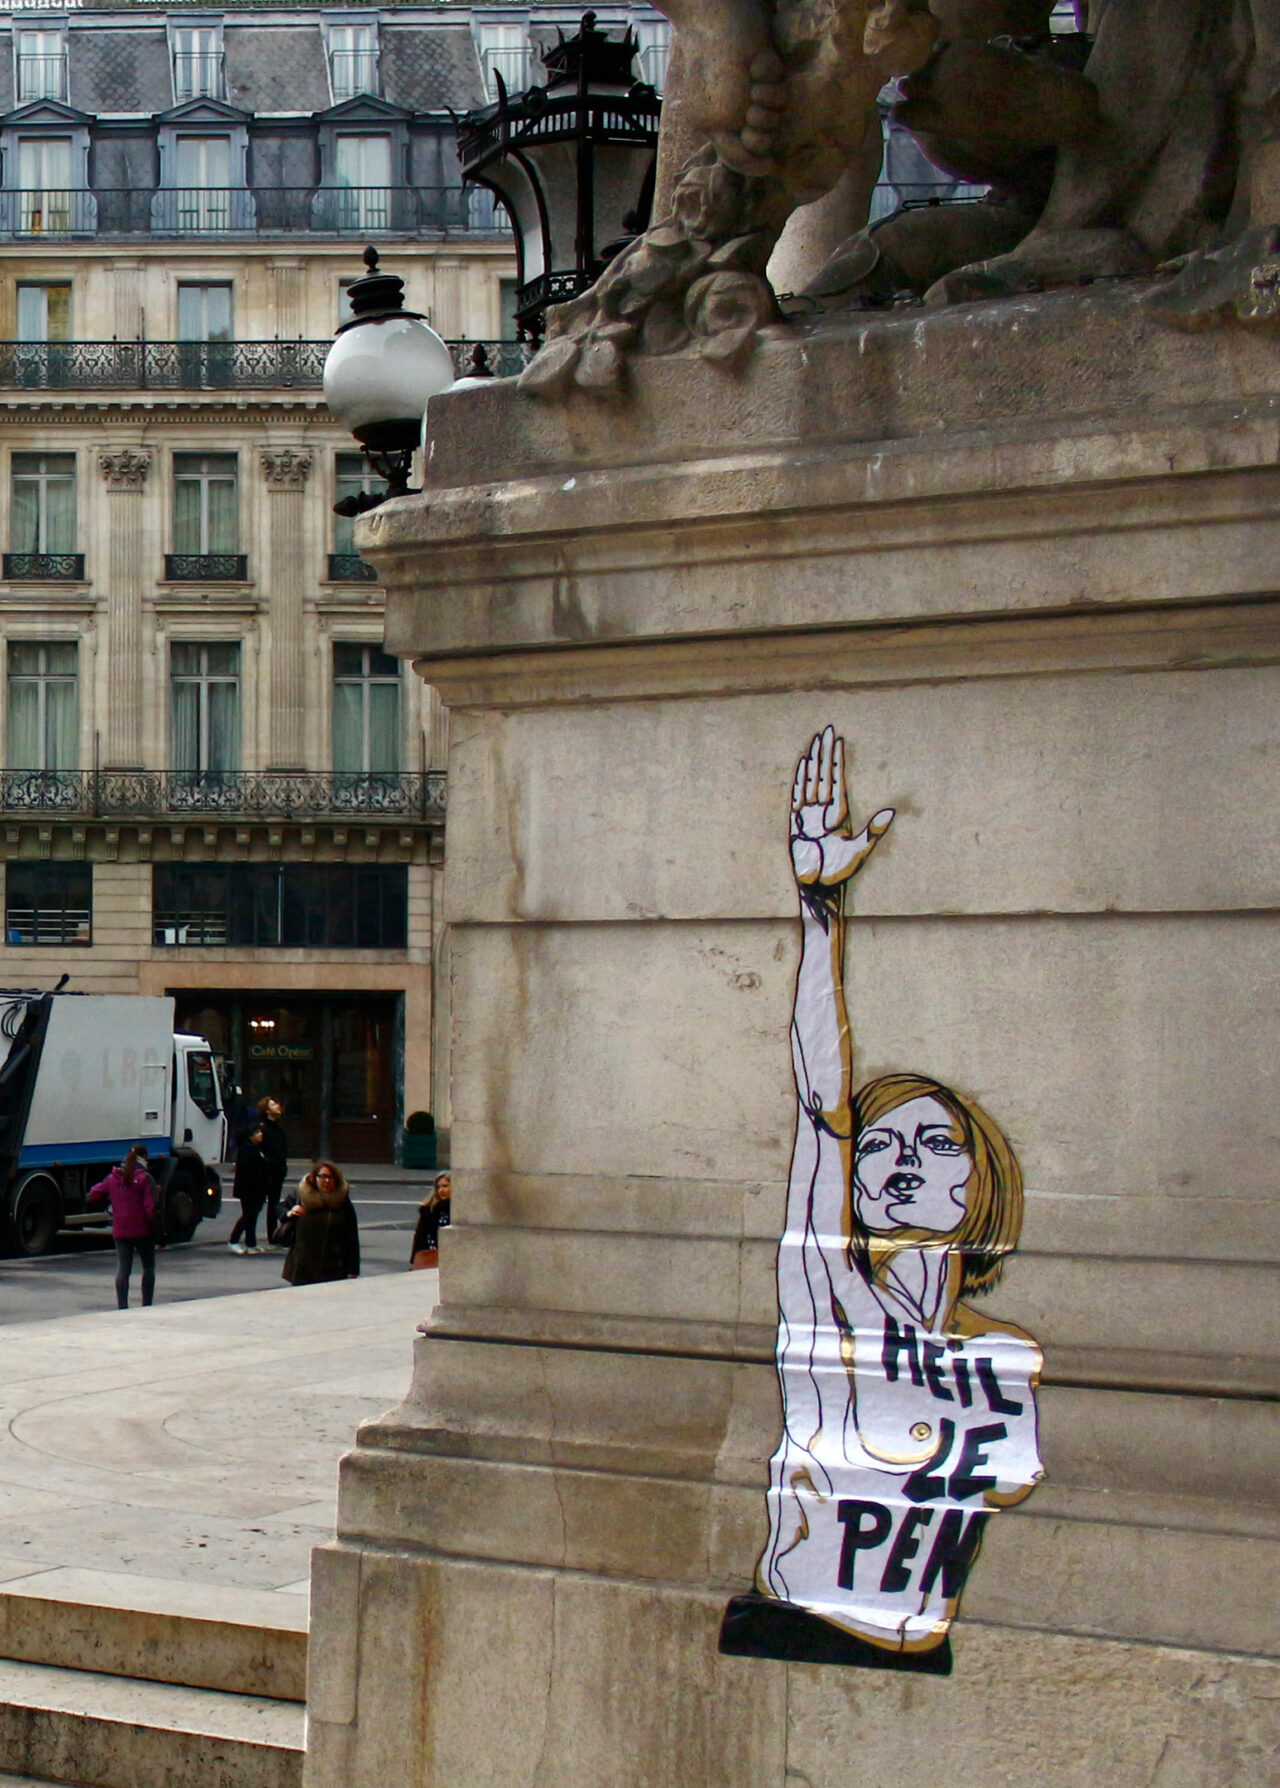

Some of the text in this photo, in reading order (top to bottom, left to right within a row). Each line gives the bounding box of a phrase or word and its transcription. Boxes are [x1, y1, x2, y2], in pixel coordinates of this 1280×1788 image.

[251, 1044, 276, 1057] Café
[901, 1417, 1008, 1502] LE
[836, 1498, 991, 1600] PEN
